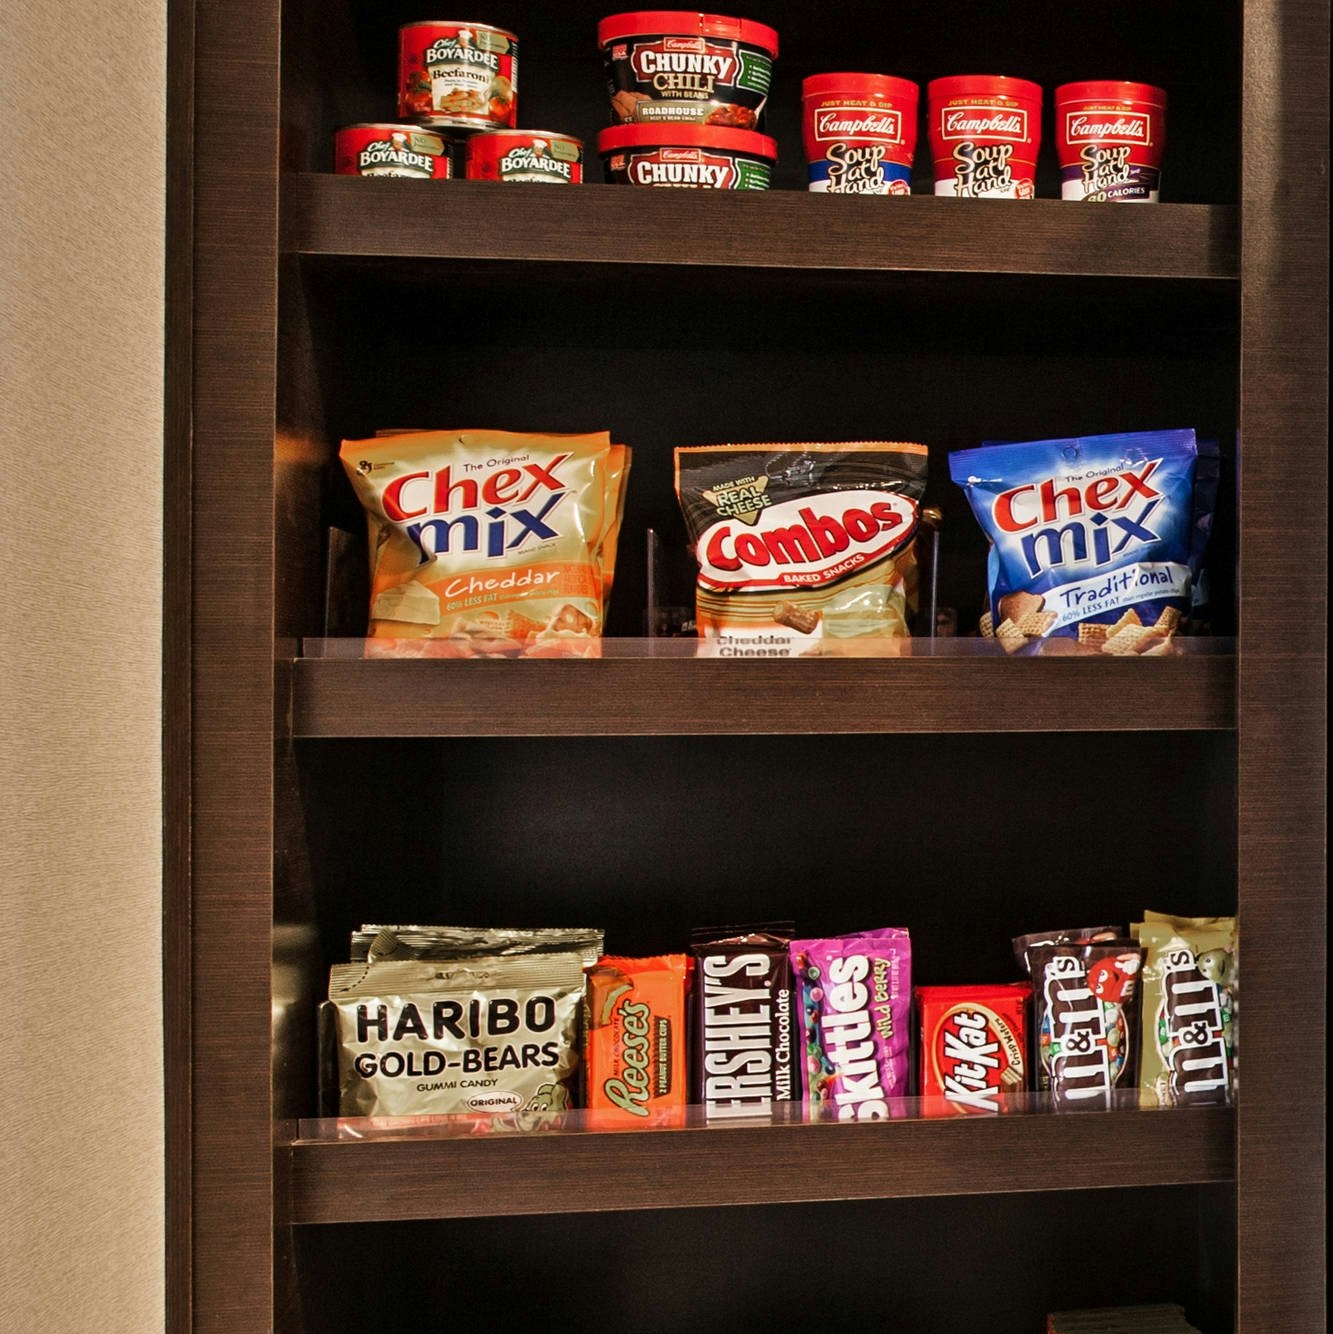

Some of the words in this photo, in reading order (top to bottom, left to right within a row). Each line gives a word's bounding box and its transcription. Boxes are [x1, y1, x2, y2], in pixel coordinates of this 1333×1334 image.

[426, 48, 499, 69] BOYARDEE
[640, 51, 733, 80] CHUNKY
[652, 73, 715, 93] CHILI
[642, 107, 704, 116] ROADHOUSE
[819, 110, 896, 135] Campbell's
[945, 112, 1022, 134] Campbell's
[1070, 115, 1145, 138] Campbell's
[360, 151, 433, 172] BOYARDEE
[501, 156, 571, 179] BOYARDEE
[826, 143, 885, 171] Soup
[953, 143, 1013, 171] Soup
[1079, 145, 1131, 172] Soup
[637, 161, 729, 188] CHUNKY
[848, 160, 871, 180] at
[829, 172, 884, 194] Hand
[956, 172, 1011, 197] Hand
[464, 463, 484, 473] The
[486, 454, 530, 468] Original
[1065, 474, 1085, 483] The
[1085, 463, 1126, 479] Original
[381, 450, 575, 523] Chex
[712, 480, 735, 493] MADE
[735, 475, 756, 487] WITH
[717, 485, 765, 507] REAL
[992, 457, 1165, 534] Chex
[715, 494, 774, 518] CHEESE
[406, 491, 567, 568] mix
[706, 501, 904, 572] Combos
[1020, 496, 1165, 579] mix
[783, 572, 821, 584] BAKED
[822, 552, 866, 580] SNACKS
[444, 568, 561, 599] Cheddar
[1059, 565, 1174, 609] Traditional
[719, 646, 791, 657] Cheese
[355, 996, 557, 1044] HARIBO
[774, 988, 791, 1063] Chocolate
[703, 953, 773, 1122] ERSHEY'S
[354, 1041, 561, 1079] GOLD-BEARS
[416, 1079, 458, 1092] GUMMI
[459, 1078, 499, 1089] CANDY
[775, 1064, 791, 1101] Milk
[469, 1096, 519, 1107] ORIGINAL
